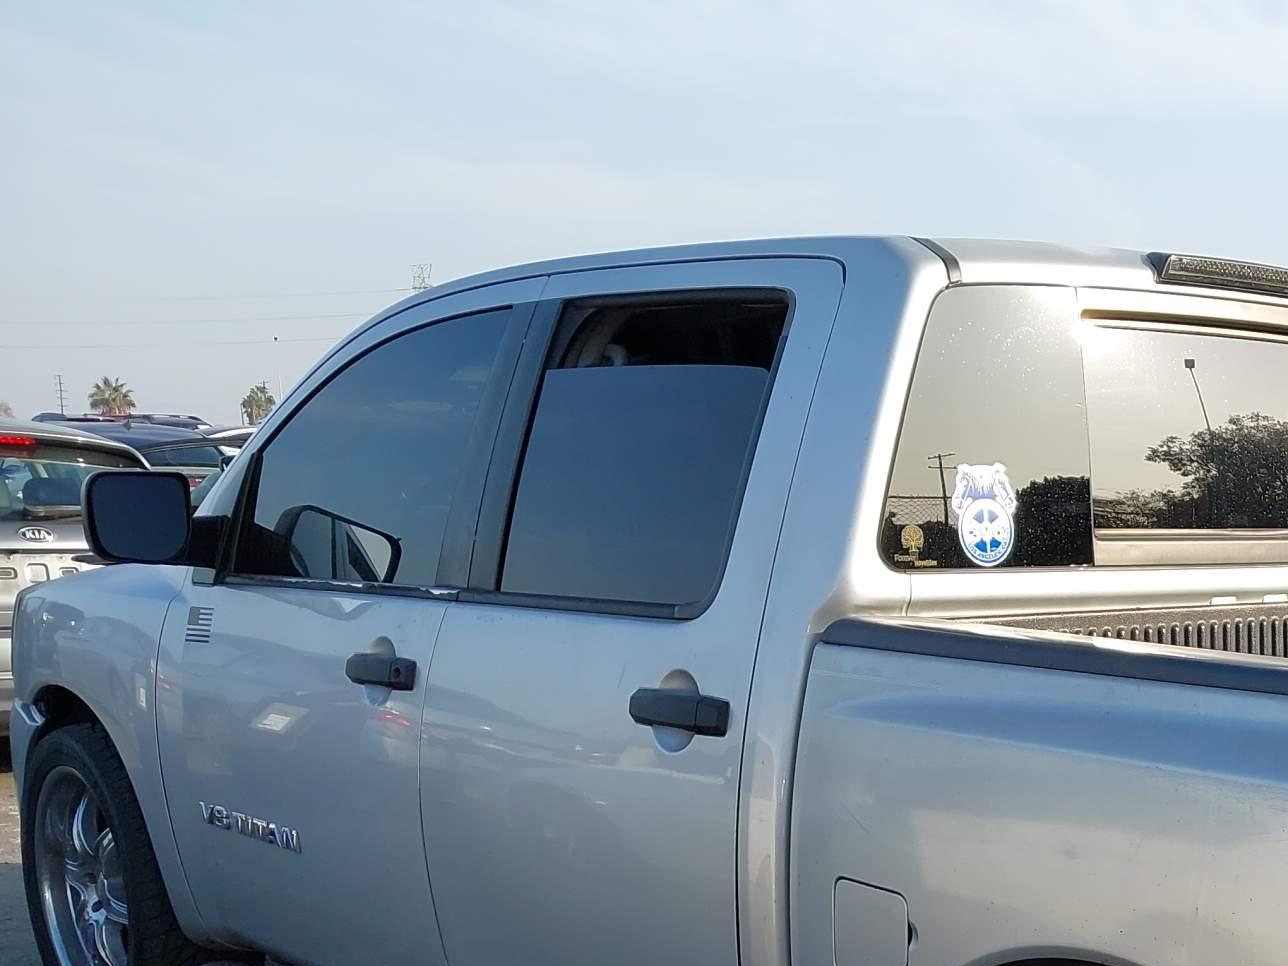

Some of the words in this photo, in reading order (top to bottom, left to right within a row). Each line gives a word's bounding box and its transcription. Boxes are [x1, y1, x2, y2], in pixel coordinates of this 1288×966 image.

[25, 529, 48, 540] KIA
[199, 801, 229, 829] V8
[231, 811, 302, 853] TITAN
